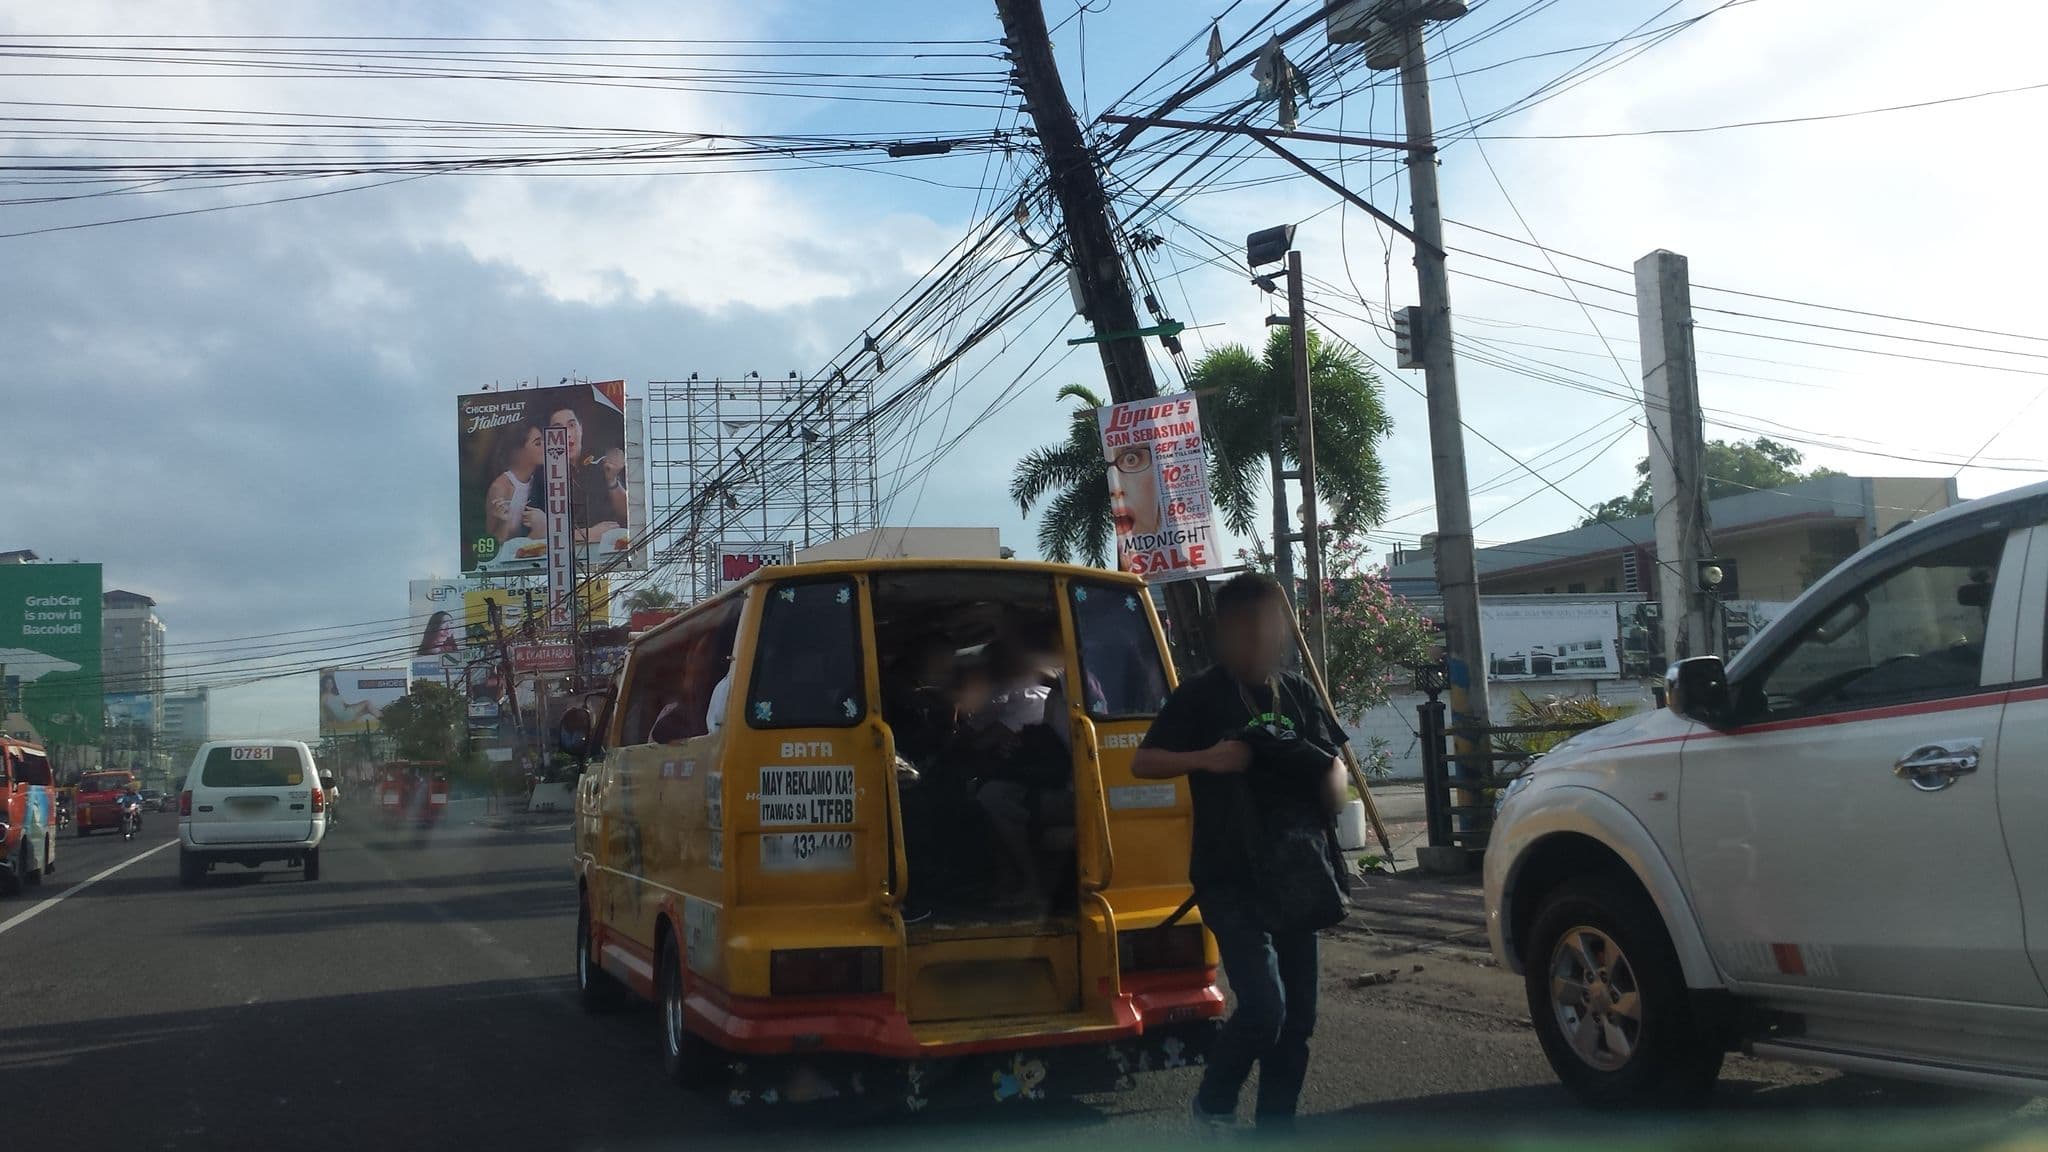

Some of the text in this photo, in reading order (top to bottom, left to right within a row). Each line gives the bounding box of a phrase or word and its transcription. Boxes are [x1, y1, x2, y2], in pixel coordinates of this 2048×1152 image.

[465, 402, 526, 414] CHICKEN FILLET
[1105, 399, 1191, 434] Lopue's
[467, 412, 525, 434] Italiana
[1106, 421, 1195, 447] SAN SEBASTIAN
[1155, 441, 1182, 455] SEPT.
[1185, 436, 1200, 449] 30
[1124, 525, 1210, 554] MIDNIGHT
[1130, 545, 1206, 576] SALE
[25, 595, 83, 607] GrabCar
[507, 586, 549, 597] BOYSE
[24, 609, 82, 621] is now in
[23, 623, 82, 635] Bacolod!
[234, 747, 272, 760] 0781
[781, 741, 832, 758] BATA
[762, 771, 783, 796] MAY
[786, 770, 832, 795] REKLAMO
[835, 770, 854, 794] KA?
[762, 798, 854, 824] ITAWAG SA LTFRB
